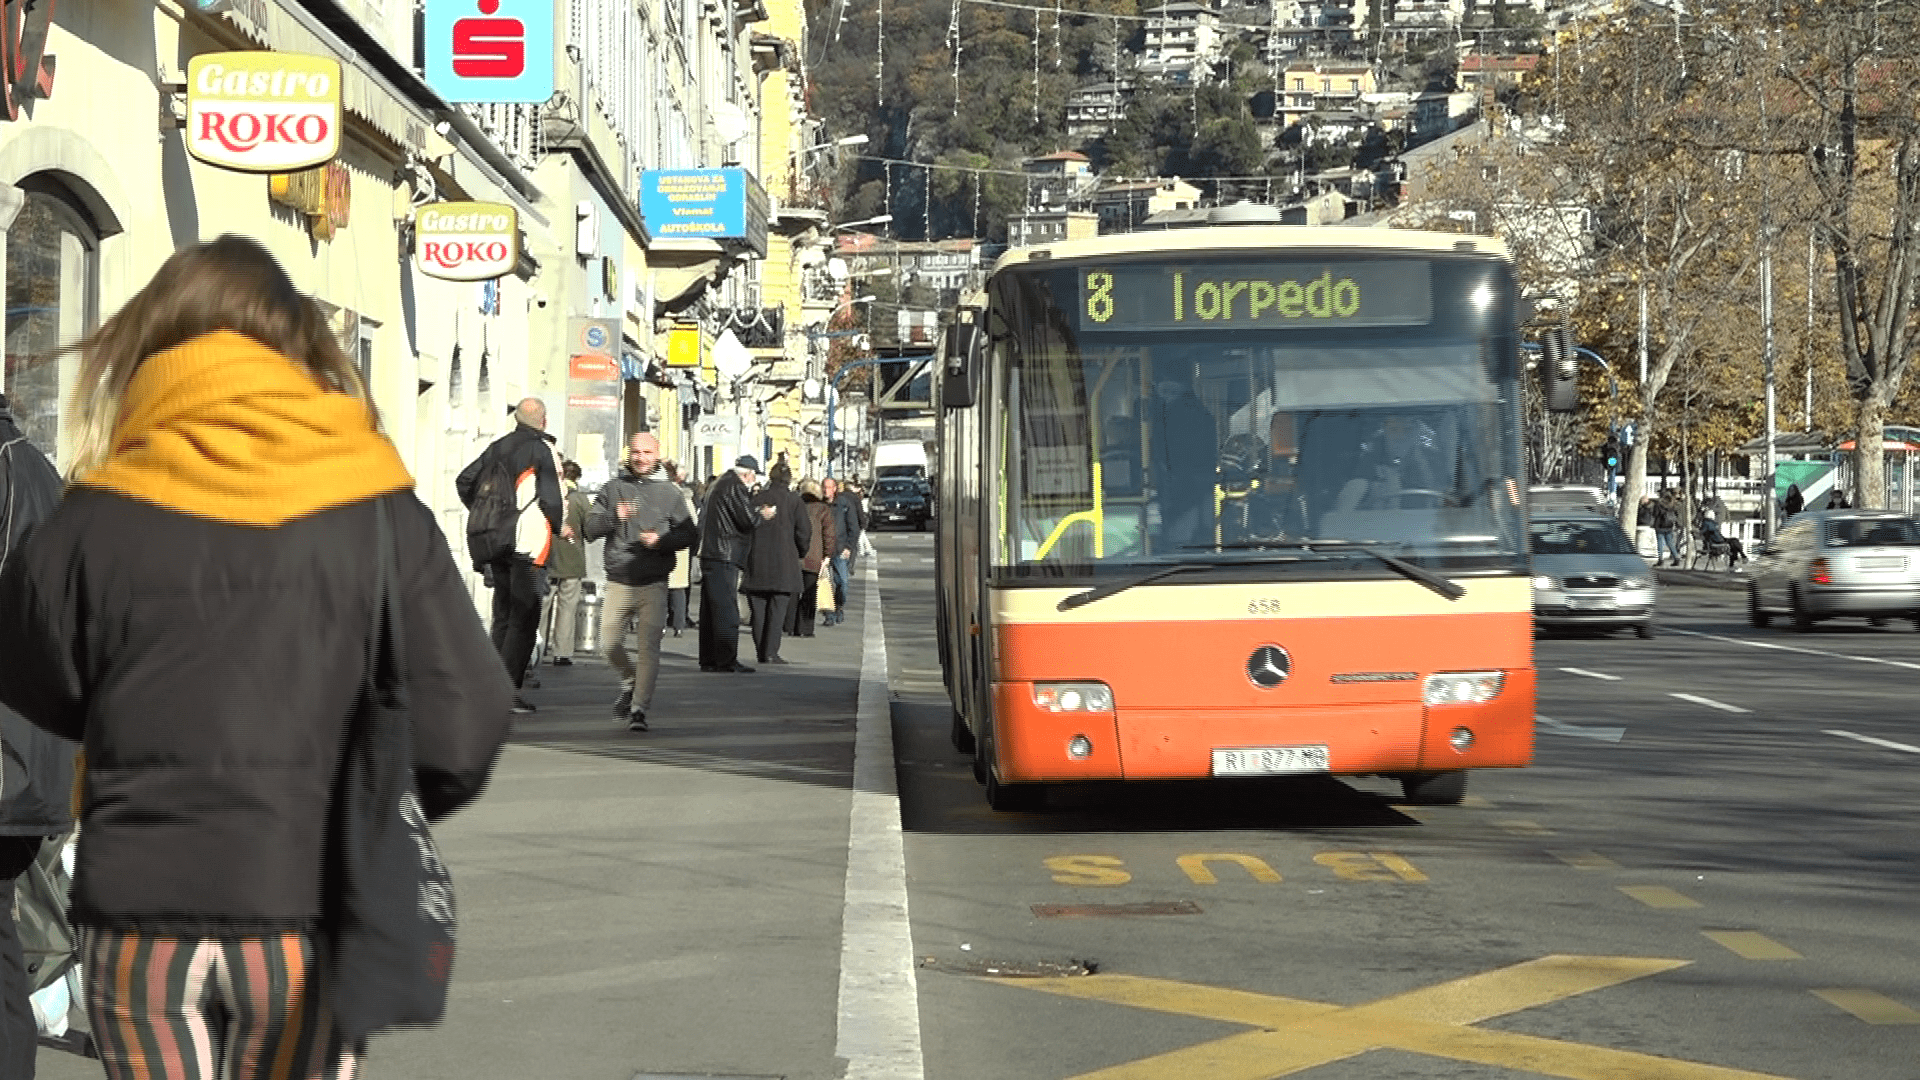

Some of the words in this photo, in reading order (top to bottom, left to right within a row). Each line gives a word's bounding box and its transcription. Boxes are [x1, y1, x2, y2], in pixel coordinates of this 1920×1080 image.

[196, 63, 330, 98] Gastro
[198, 111, 328, 153] ROKO
[421, 210, 509, 233] Gastro
[660, 221, 726, 233] AUTOŠKOLA
[423, 241, 508, 269] ROKO
[1087, 271, 1114, 322] 8
[1247, 599, 1281, 615] 658
[1225, 751, 1246, 772] RI
